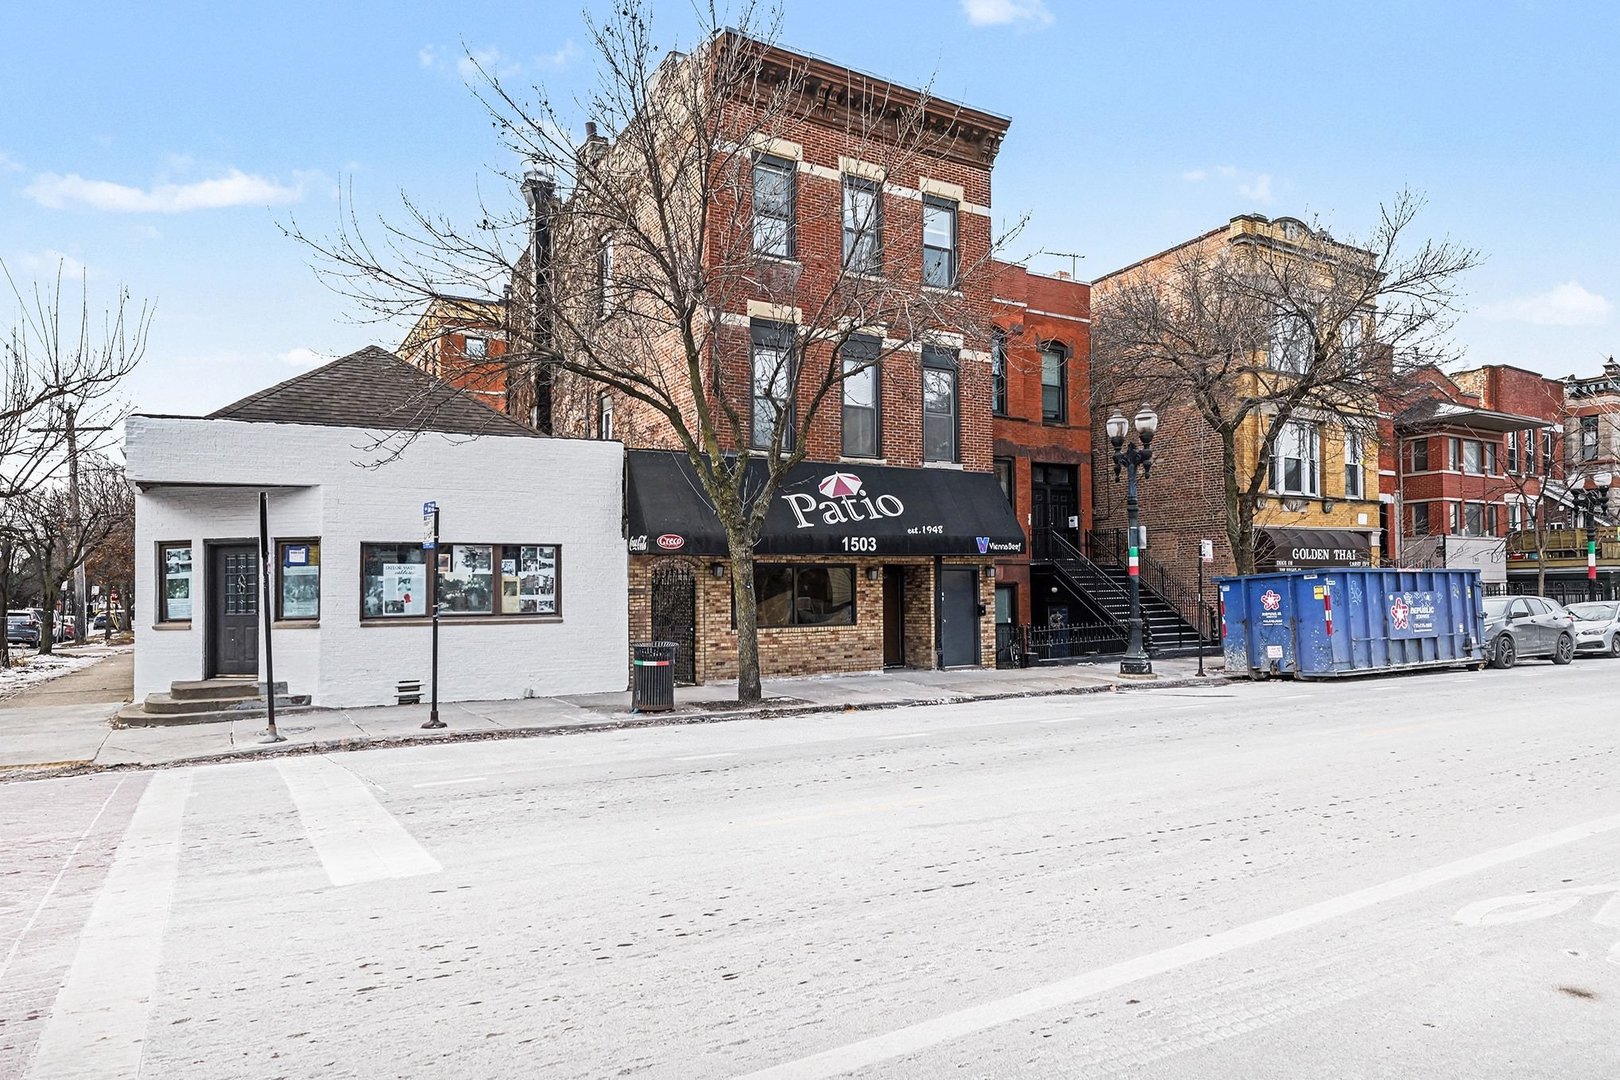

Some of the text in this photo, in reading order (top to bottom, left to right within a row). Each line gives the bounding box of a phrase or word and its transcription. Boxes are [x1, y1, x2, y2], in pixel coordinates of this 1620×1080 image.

[781, 489, 904, 529] Patio
[842, 537, 877, 551] 1503
[1292, 548, 1356, 560] GOLDEN THAI
